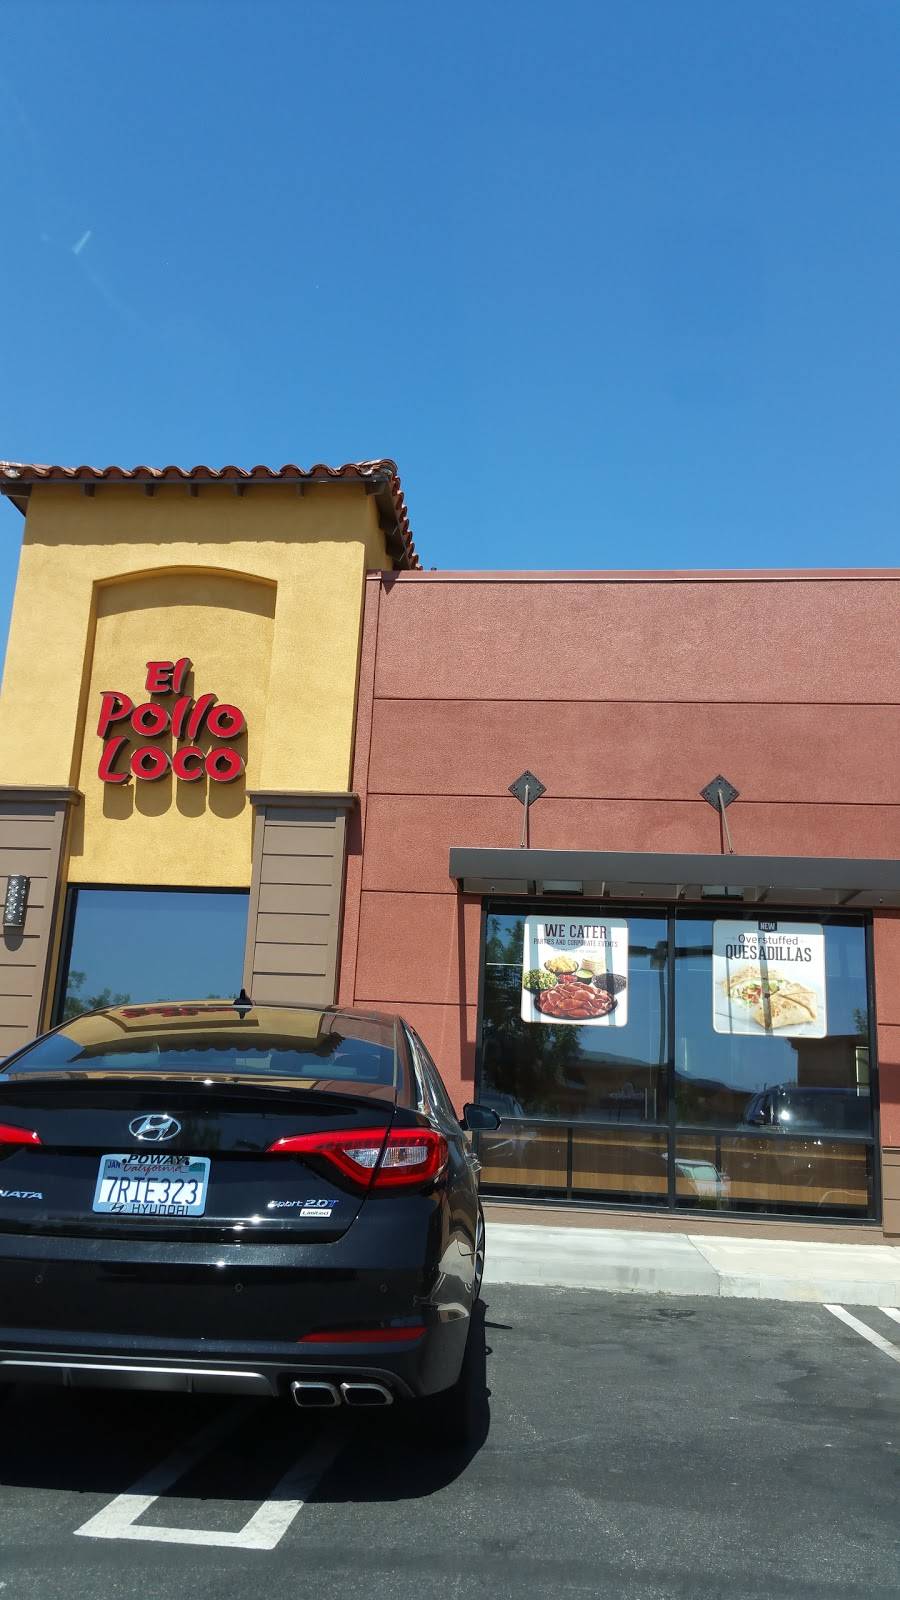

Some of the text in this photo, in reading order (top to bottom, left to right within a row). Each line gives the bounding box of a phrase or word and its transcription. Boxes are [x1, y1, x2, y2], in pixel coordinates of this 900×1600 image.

[145, 657, 193, 694] El
[97, 691, 246, 740] Pollo
[98, 735, 245, 784] Loco
[544, 923, 607, 940] WE CATER
[759, 922, 775, 930] NEW
[533, 937, 619, 949] PARTIES AND CORPORATE EVENTS
[738, 934, 799, 946] Overstuffed
[725, 944, 812, 962] QUESADILLAS
[107, 1160, 121, 1169] JAN
[127, 1154, 183, 1165] POWAY
[123, 1163, 182, 1176] California
[106, 1176, 199, 1205] 7RIE323
[132, 1203, 189, 1216] HYUNDAI
